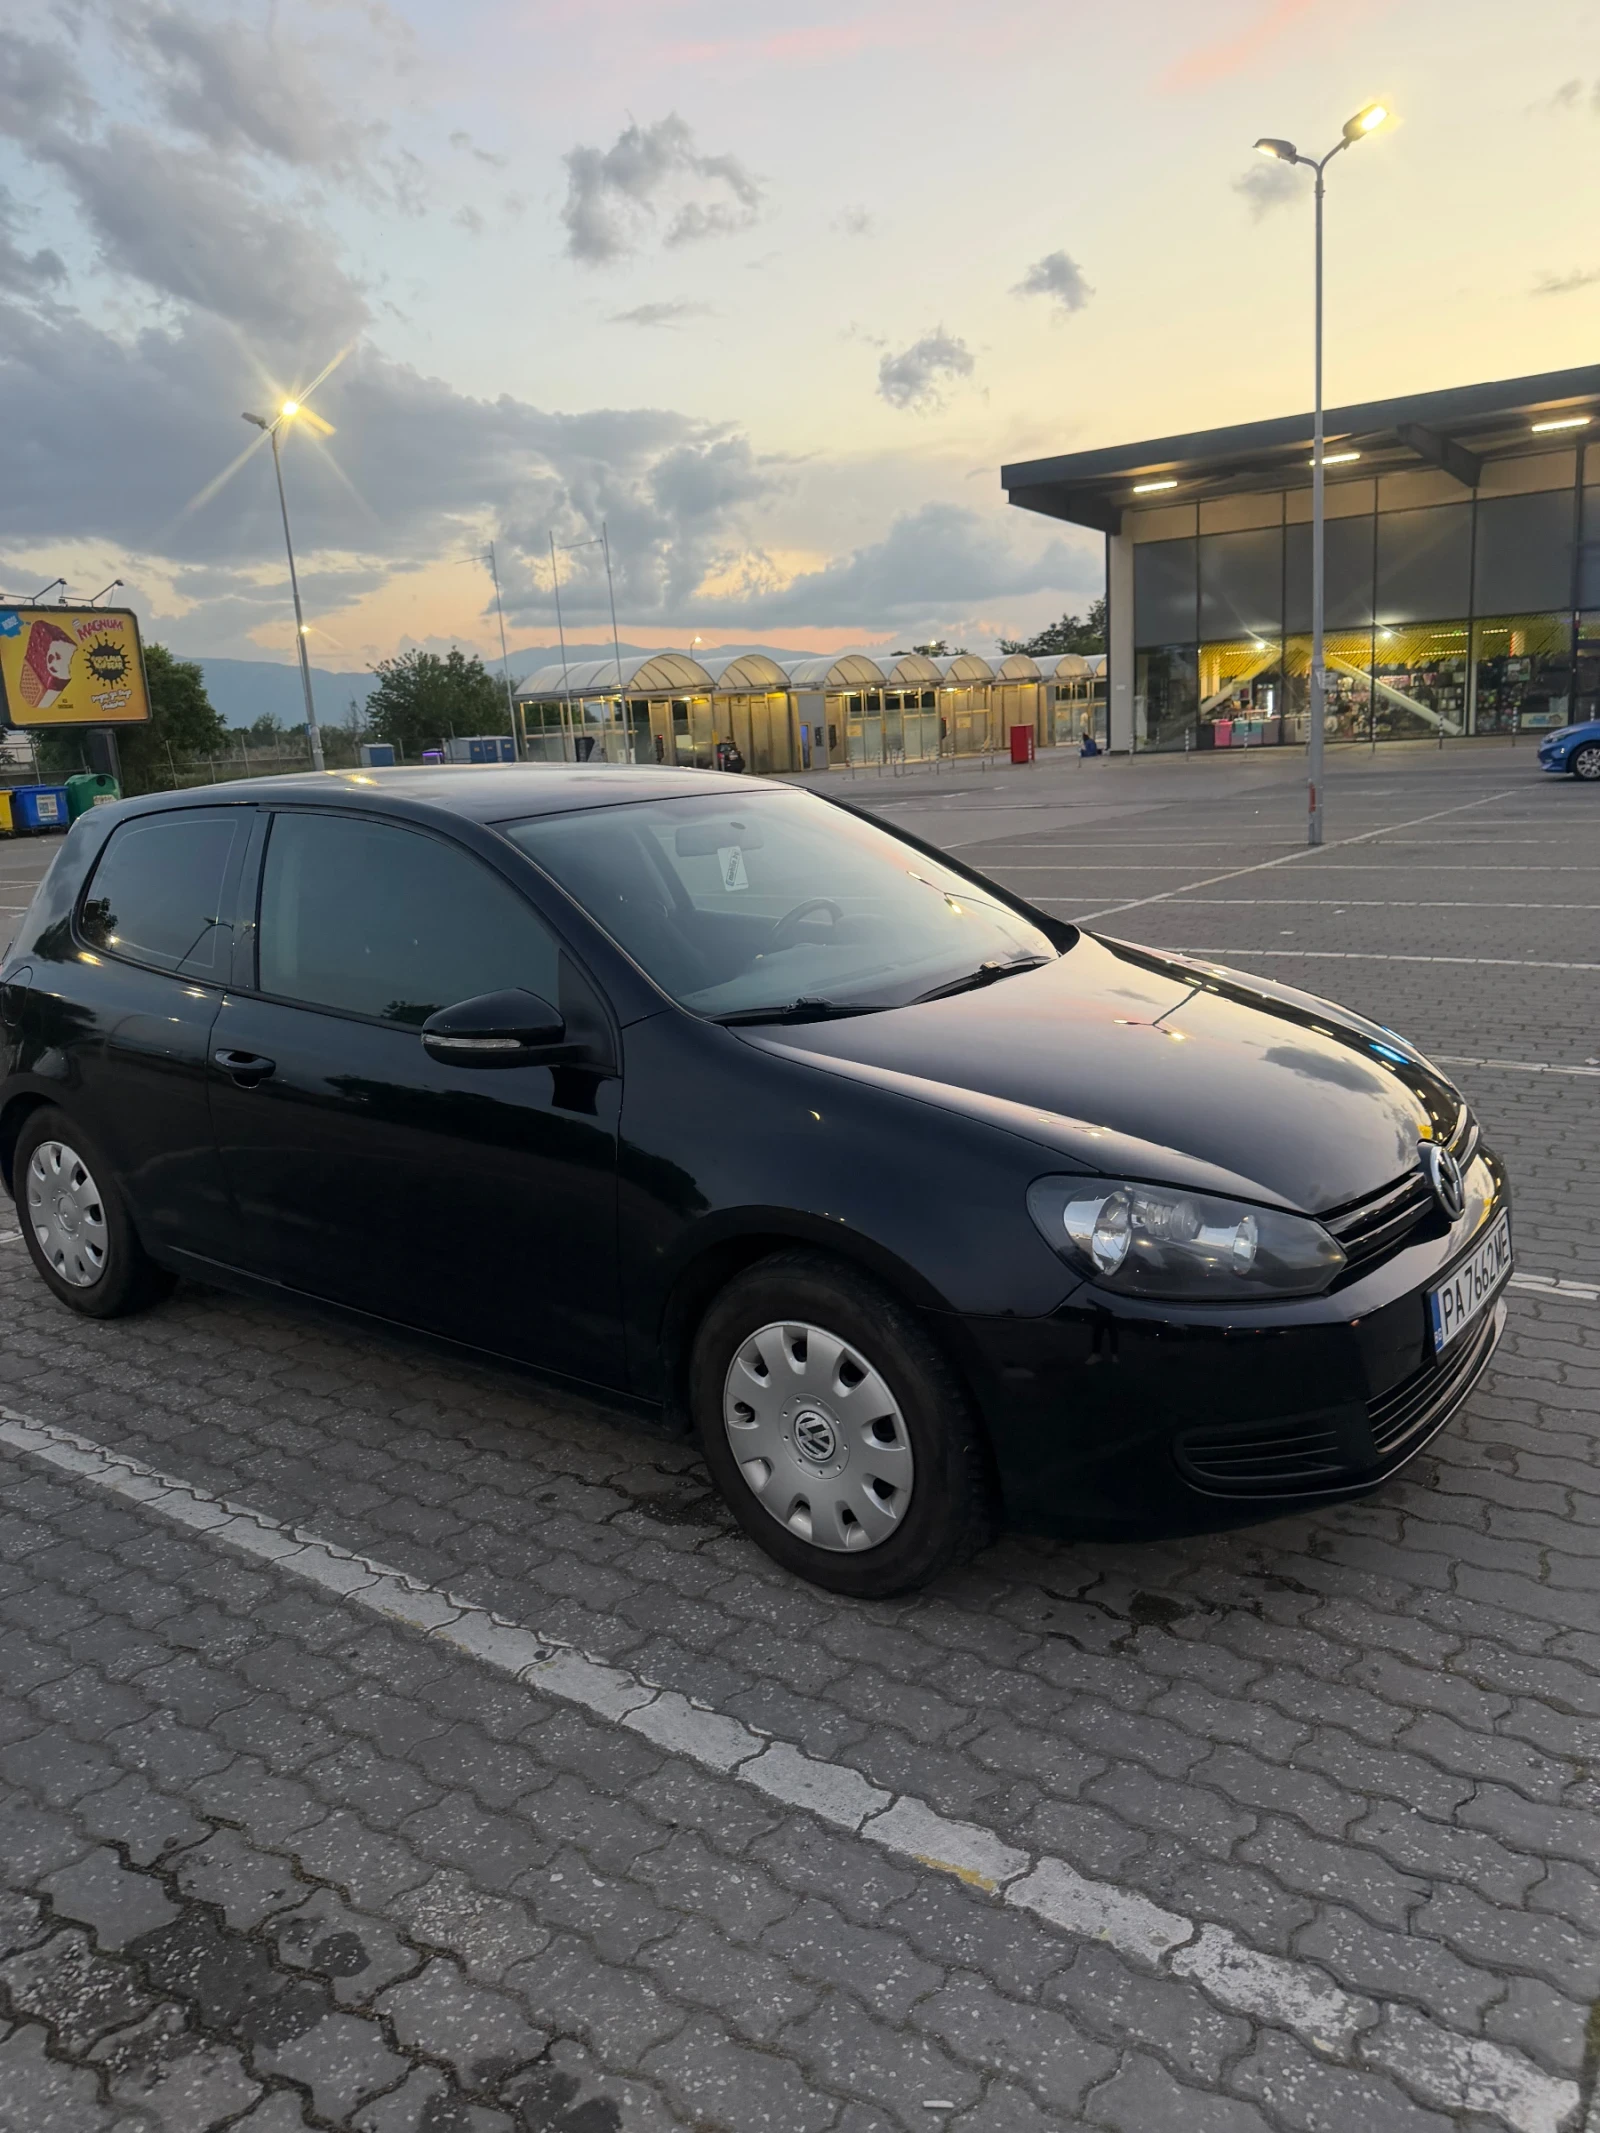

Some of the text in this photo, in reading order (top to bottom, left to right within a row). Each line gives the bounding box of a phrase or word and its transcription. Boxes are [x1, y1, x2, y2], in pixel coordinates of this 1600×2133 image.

[76, 618, 124, 642] MAGNUM
[1442, 1278, 1465, 1335] PA
[1464, 1241, 1496, 1313] 7662
